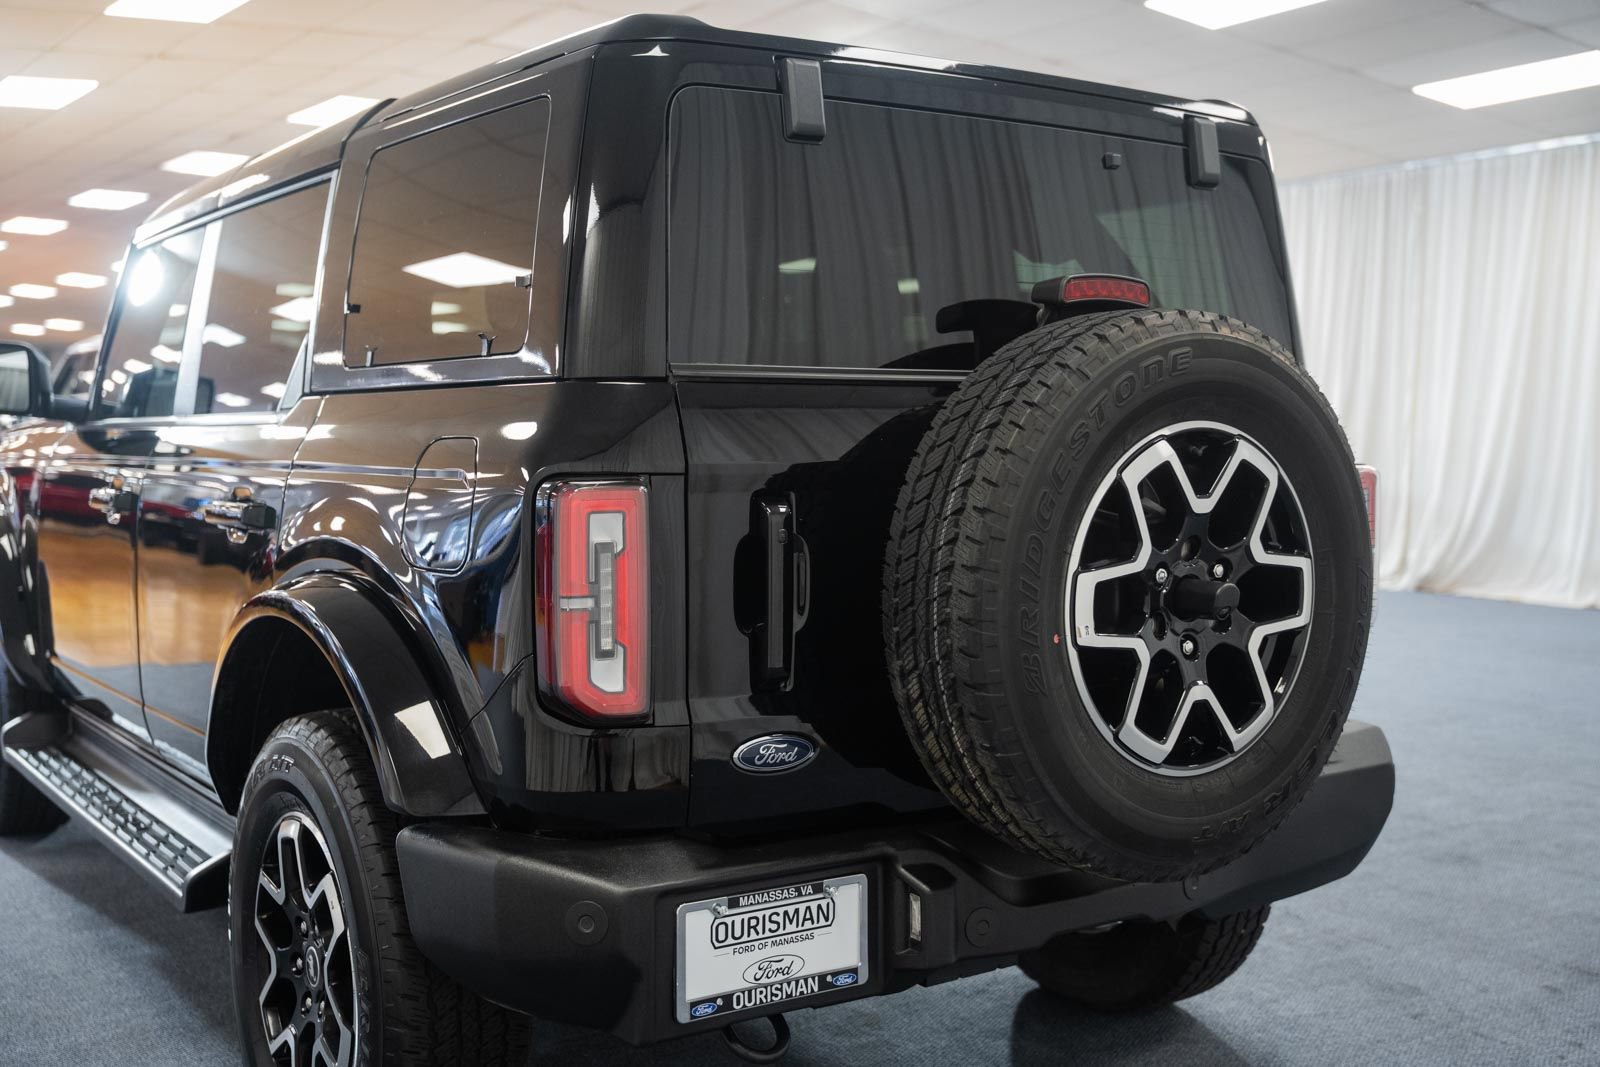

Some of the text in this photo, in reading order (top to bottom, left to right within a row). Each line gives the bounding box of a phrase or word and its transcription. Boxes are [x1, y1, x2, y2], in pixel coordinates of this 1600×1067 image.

[1019, 348, 1193, 697] BRIDGESTONE
[754, 742, 799, 765] Ford
[800, 884, 814, 896] VA
[714, 901, 831, 944] OURISMAN
[732, 932, 815, 956] FORD OF MANASSAS
[753, 957, 795, 982] Ford
[694, 973, 855, 1016] Ford OURISMAN Ford
